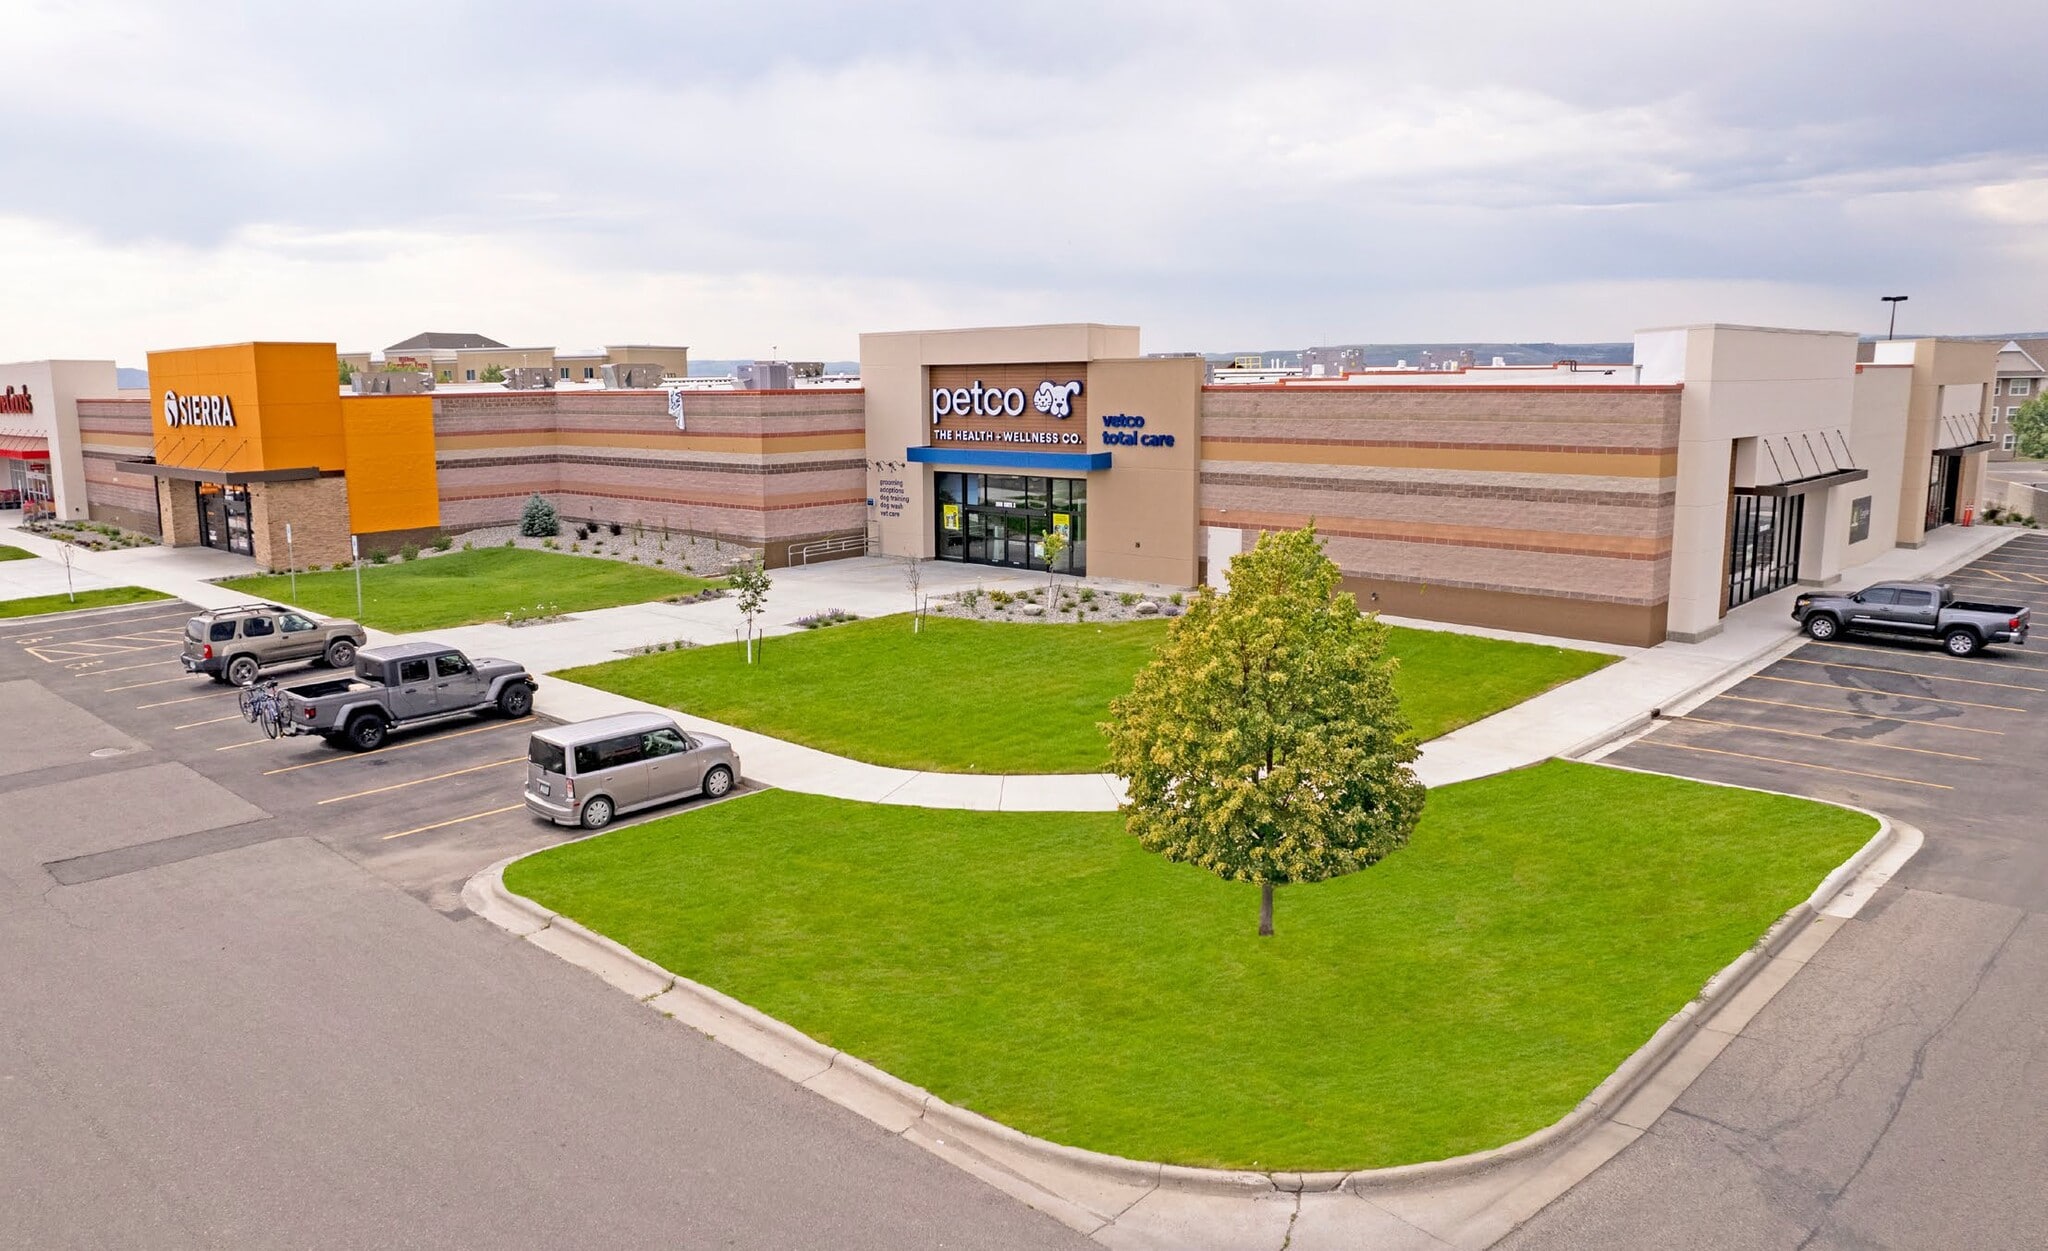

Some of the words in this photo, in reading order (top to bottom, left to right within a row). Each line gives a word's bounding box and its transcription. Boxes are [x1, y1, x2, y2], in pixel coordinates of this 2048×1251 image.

[932, 380, 1025, 424] petco
[179, 395, 237, 427] SIERRA
[1102, 414, 1145, 428] vetco
[934, 429, 953, 440] THE
[955, 430, 994, 442] HEALTH
[1003, 432, 1059, 444] WELLNESS
[1062, 433, 1084, 445] CO.
[1102, 431, 1138, 446] total
[1140, 434, 1175, 447] care
[880, 494, 889, 502] dog
[890, 495, 909, 503] training
[880, 502, 889, 510] dog
[890, 502, 904, 510] wash
